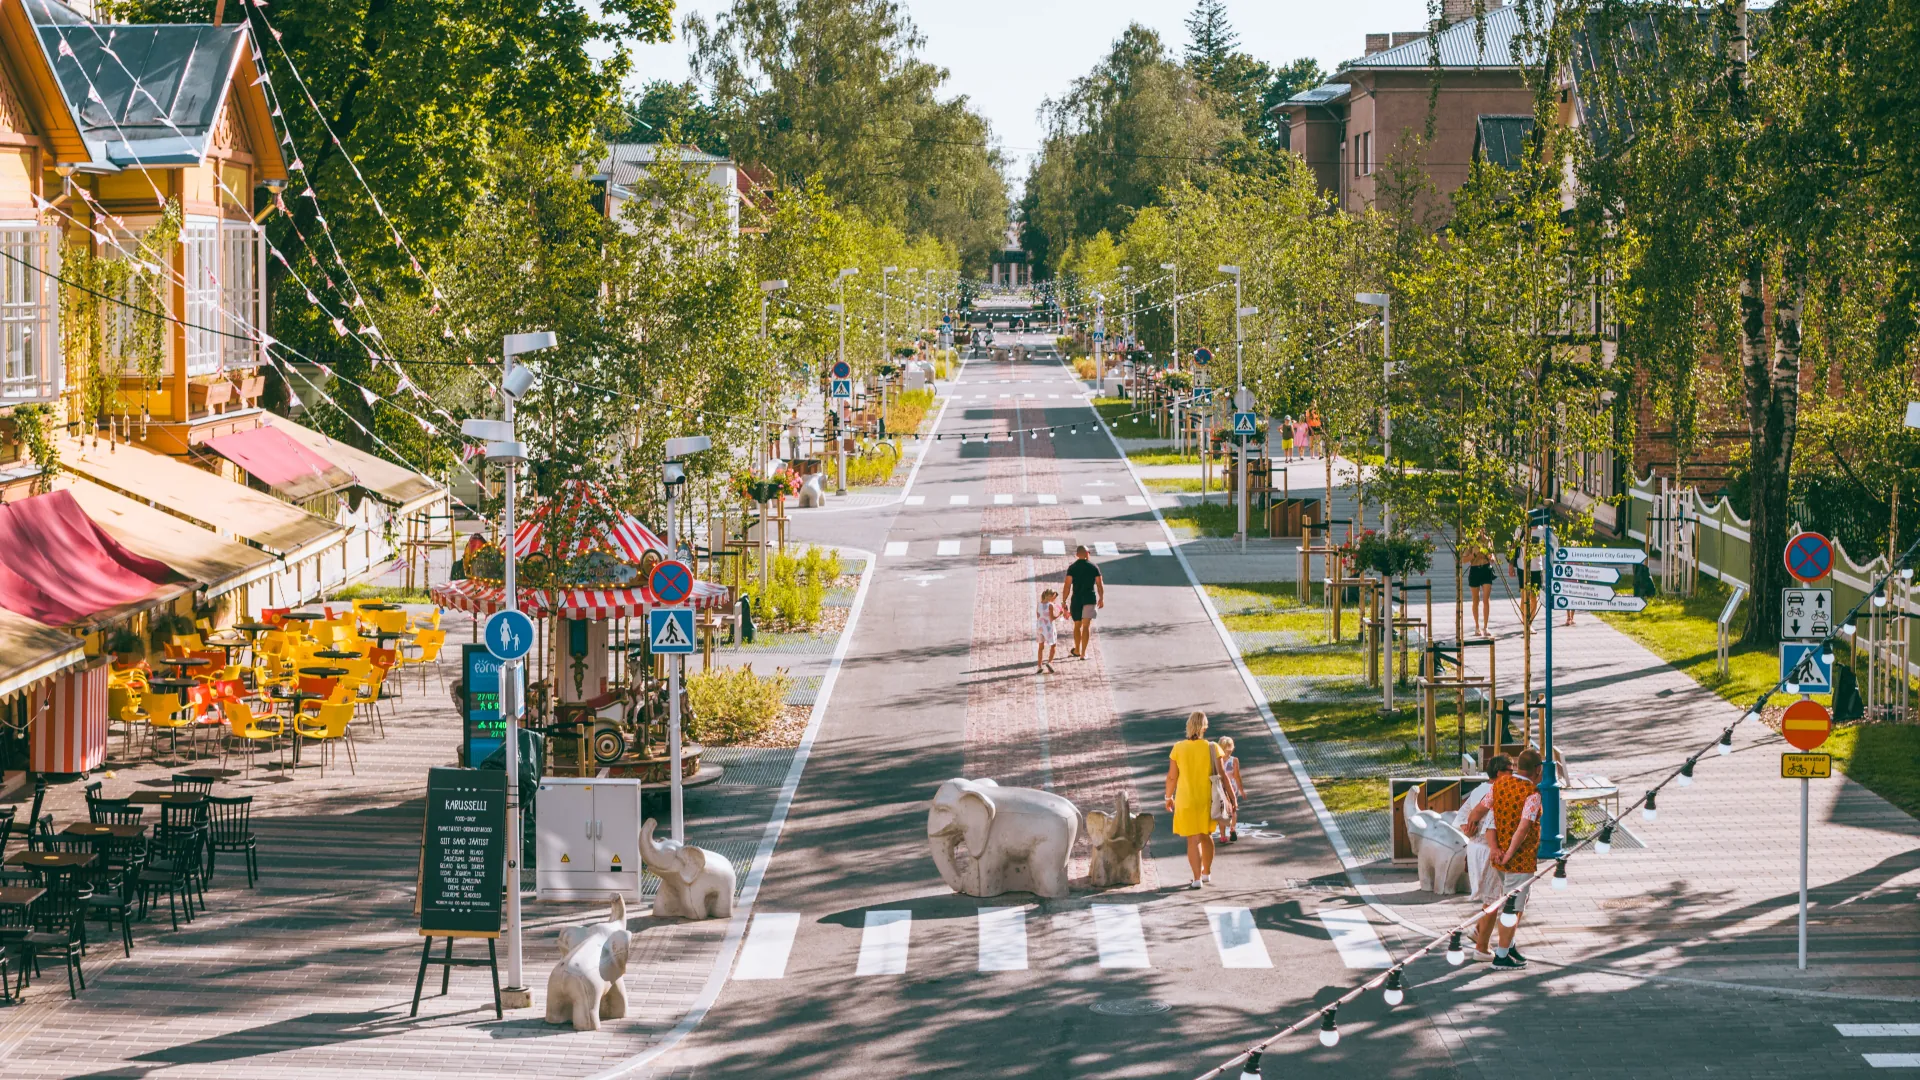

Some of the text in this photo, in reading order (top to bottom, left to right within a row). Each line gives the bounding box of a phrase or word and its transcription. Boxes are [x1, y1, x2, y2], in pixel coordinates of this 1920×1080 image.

[1616, 552, 1636, 560] Gallery
[445, 799, 487, 811] KARUSSELLI
[440, 837, 450, 845] SIIT
